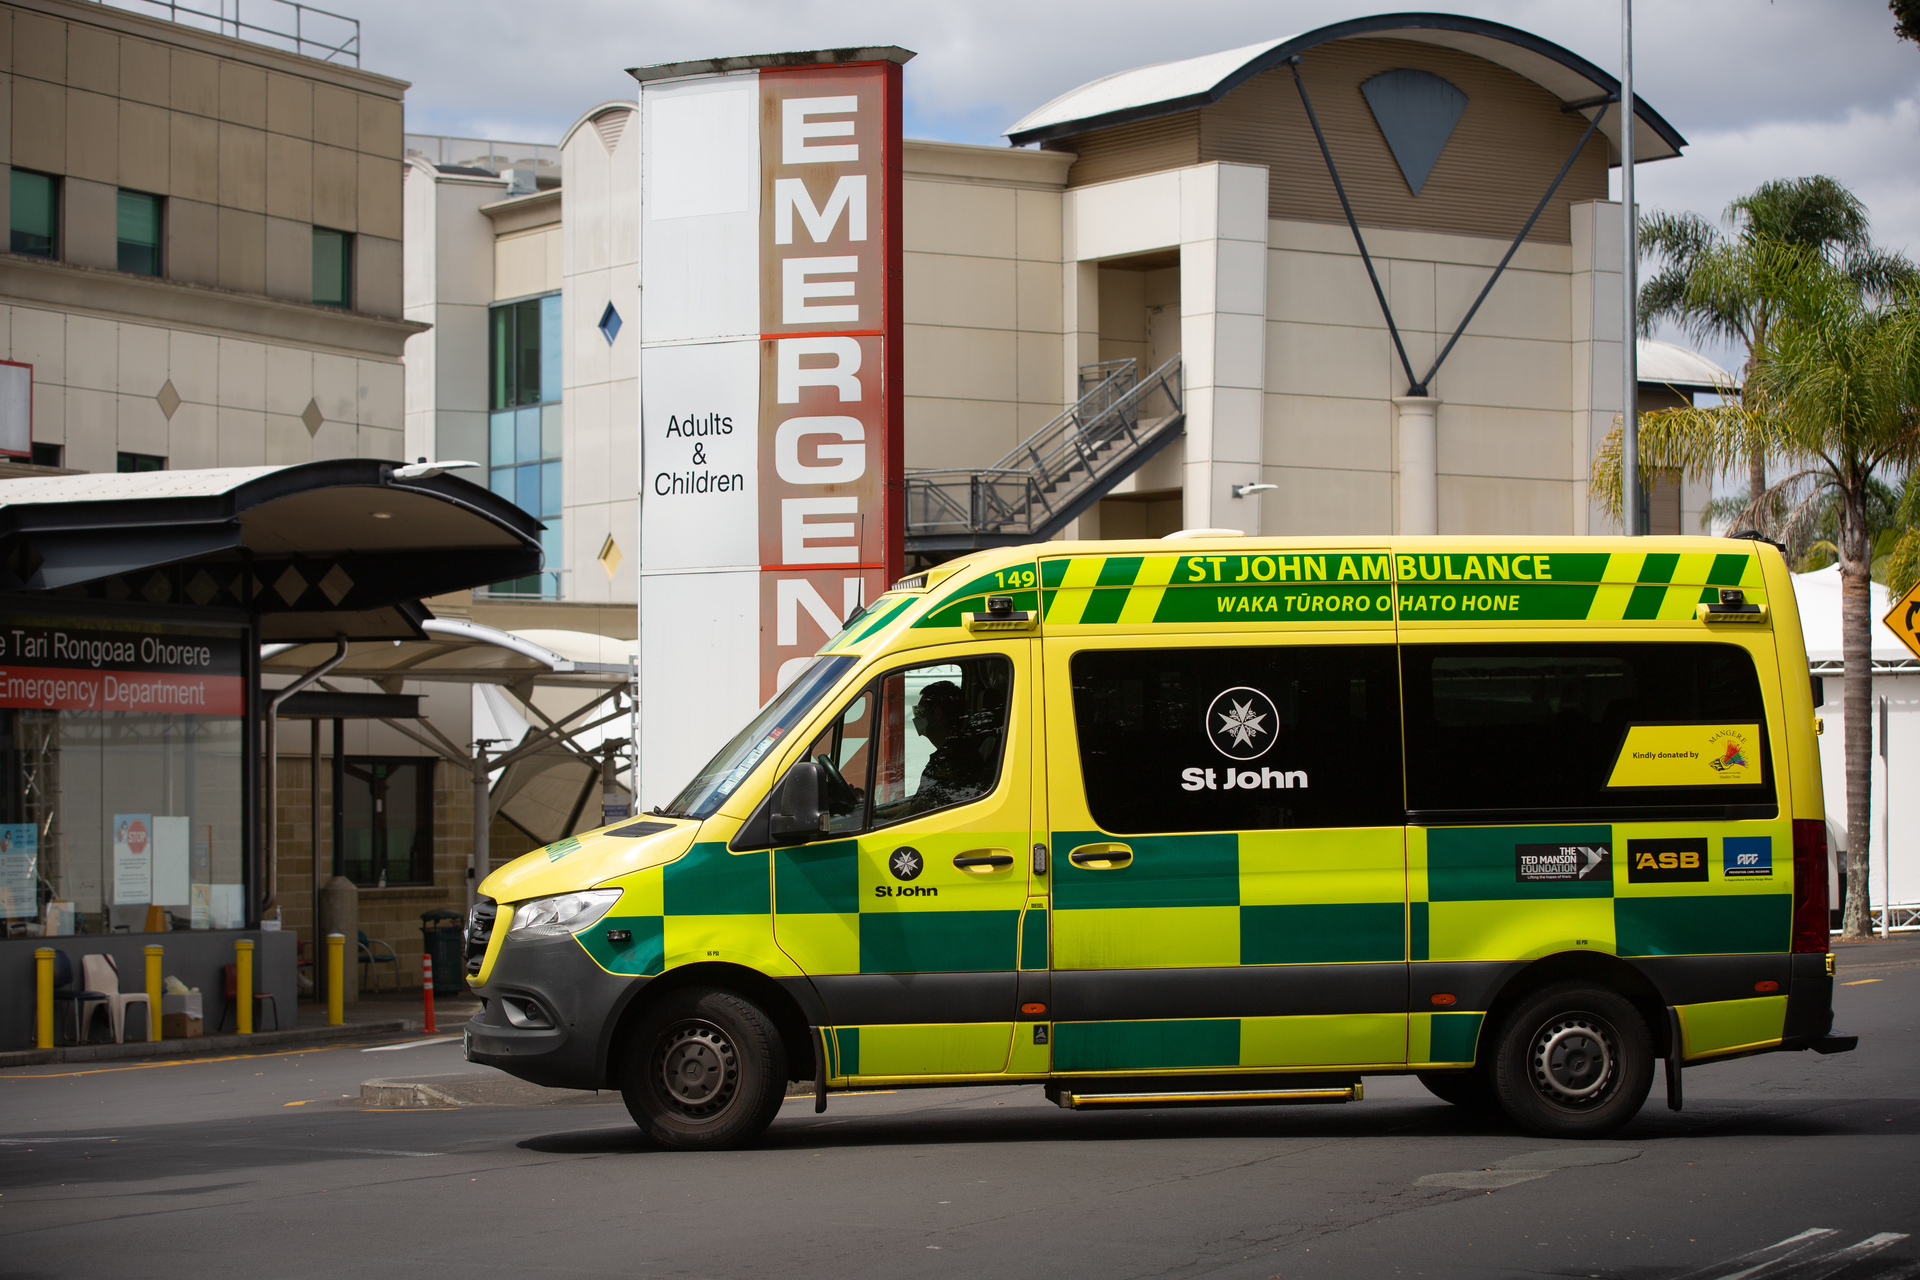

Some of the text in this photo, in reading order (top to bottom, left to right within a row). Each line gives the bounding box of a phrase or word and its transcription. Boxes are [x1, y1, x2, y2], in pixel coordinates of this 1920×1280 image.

[666, 412, 733, 438] Adults
[692, 442, 707, 465] &
[655, 470, 743, 496] Children
[1187, 555, 1552, 582] ST JOHN AMBULANCE
[995, 571, 1035, 588] 149
[1217, 596, 1278, 612] WAKA
[1284, 593, 1370, 612] TŪRORO
[1399, 595, 1456, 611] HATO
[1462, 595, 1520, 611] HONE
[11, 630, 48, 658] Tari
[54, 632, 135, 667] Rongoaa
[141, 637, 211, 666] Ohorere
[105, 675, 205, 708] Department
[1708, 729, 1747, 744] MANGERE
[1632, 752, 1656, 760] Kindly
[1690, 751, 1699, 759] by
[1181, 767, 1308, 791] St John
[128, 831, 147, 843] STOP
[1521, 855, 1577, 864] TED MANSON
[1559, 847, 1577, 855] THE
[1521, 864, 1577, 873] FOUNDATION
[1636, 852, 1700, 869] ASB
[875, 886, 938, 897] St John
